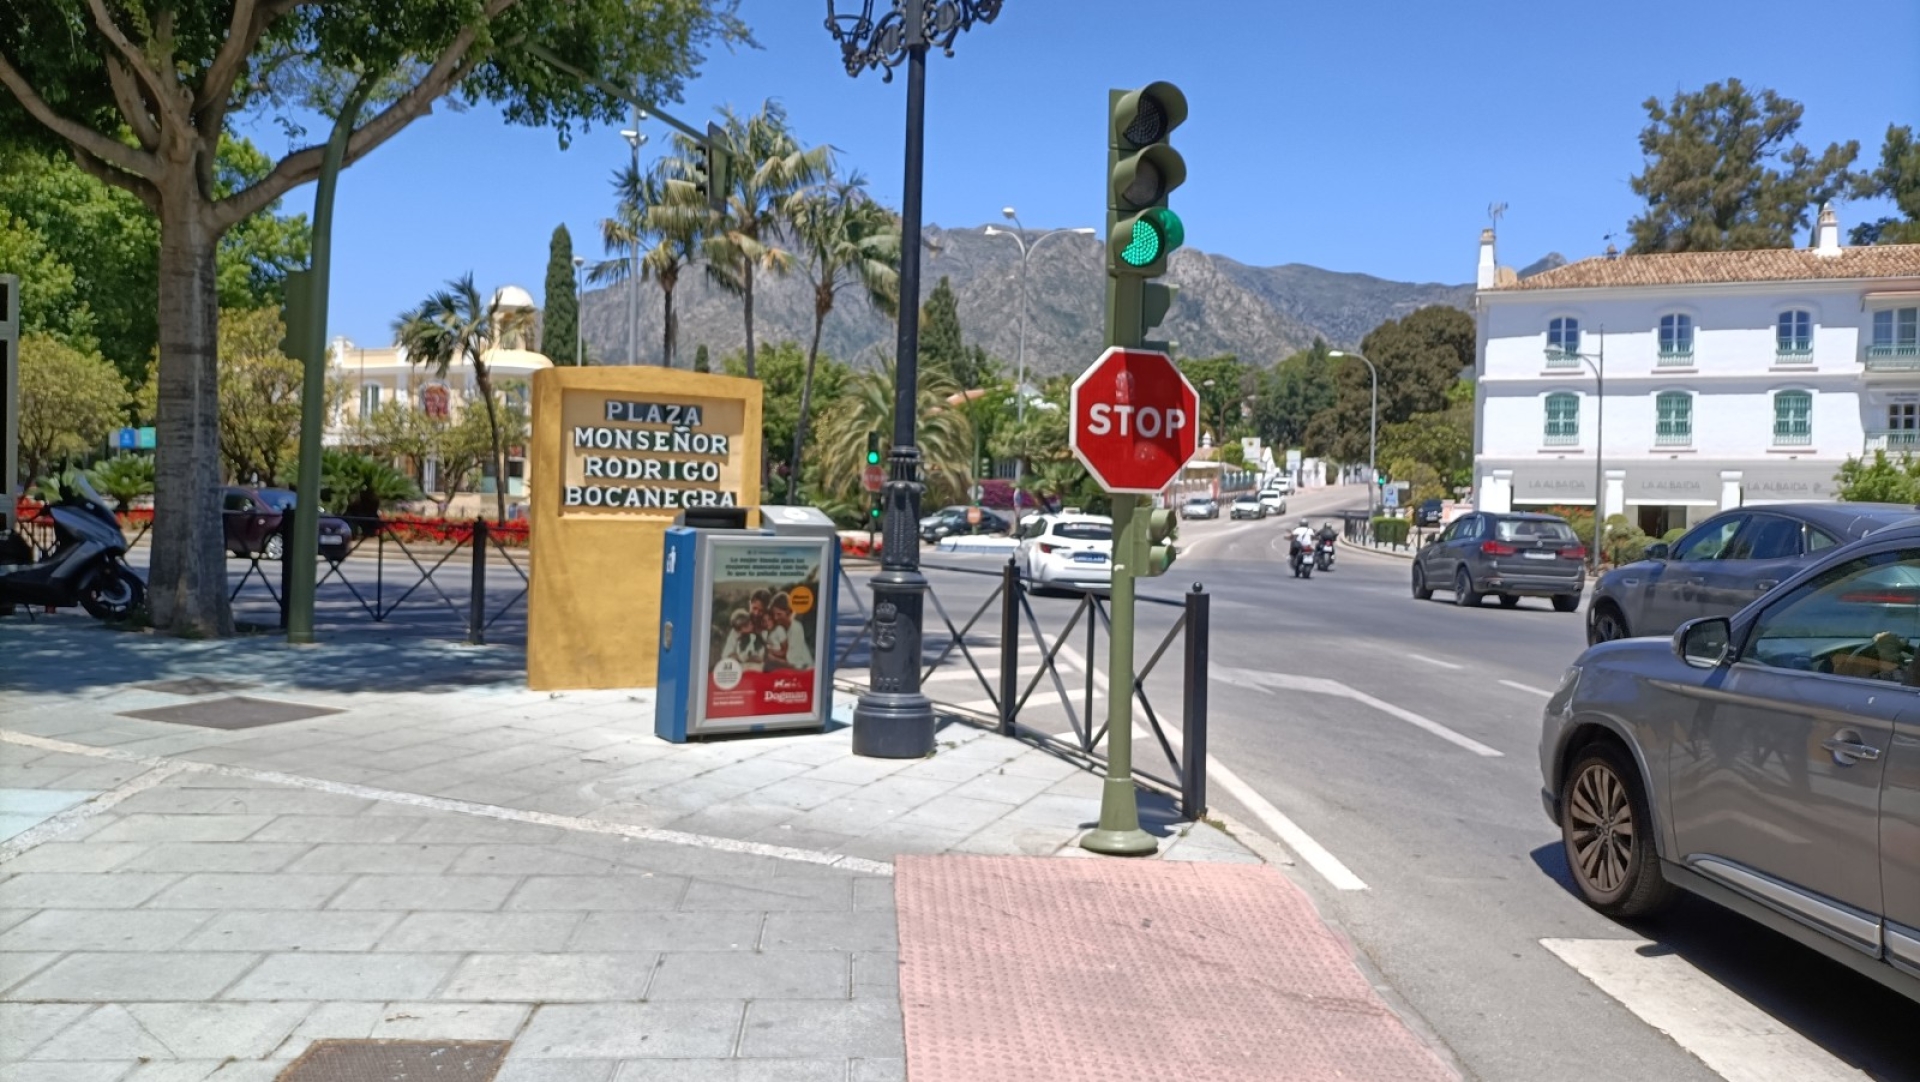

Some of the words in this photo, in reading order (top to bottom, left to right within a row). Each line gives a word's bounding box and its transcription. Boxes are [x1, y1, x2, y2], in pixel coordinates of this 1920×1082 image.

[606, 401, 702, 426] PLAZA
[1087, 402, 1186, 439] STOP
[574, 426, 728, 454] MONSEÑOR
[585, 456, 719, 482] RODRIGO
[1528, 480, 1541, 489] LA
[1642, 480, 1654, 489] LA
[1746, 481, 1760, 490] LA
[564, 486, 735, 509] BOCANEGRA
